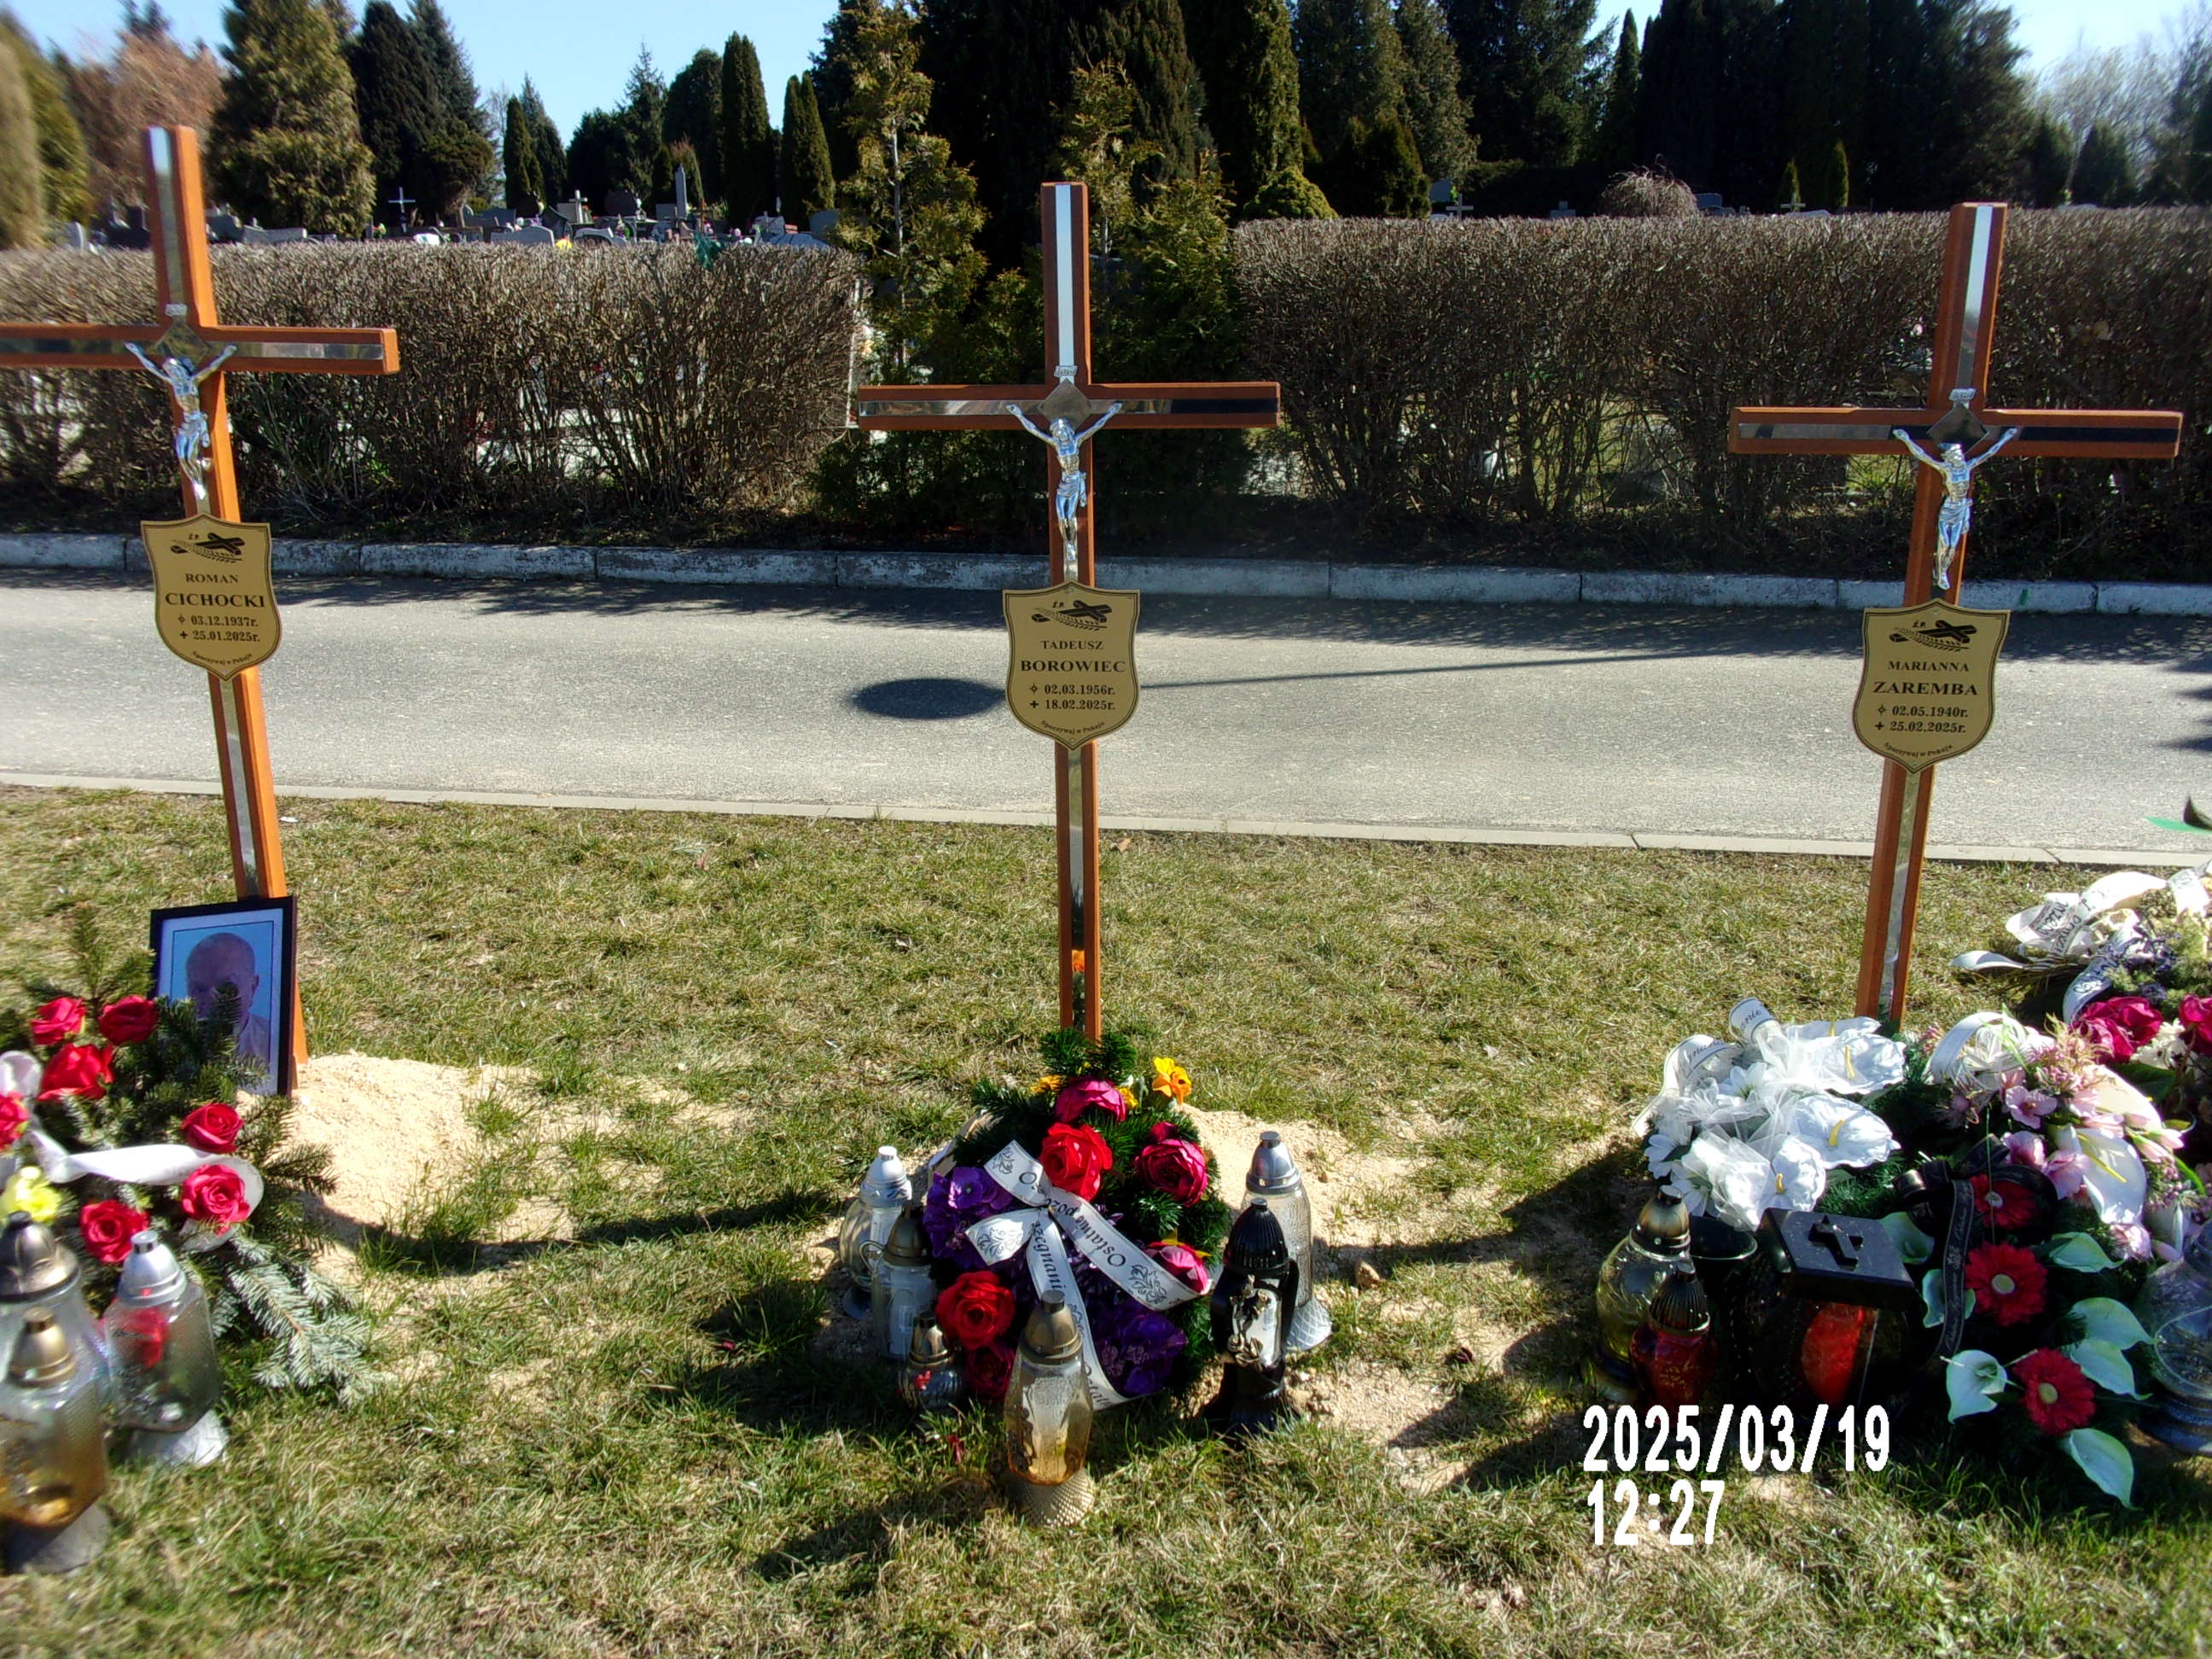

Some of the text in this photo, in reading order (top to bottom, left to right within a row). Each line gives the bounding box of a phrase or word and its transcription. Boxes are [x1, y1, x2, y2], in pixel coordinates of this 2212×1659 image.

[185, 573, 239, 584] ROMAN
[165, 592, 265, 608] CICHOCKI
[190, 615, 259, 627] 03.12.1937r.
[192, 631, 260, 643] 25.01.2025r.
[1041, 640, 1104, 650] TADEUSZ
[1021, 661, 1126, 673] BOROWIEC
[1887, 661, 1970, 672] MARIANNA
[1044, 684, 1115, 696] 02.03.1956r.
[1872, 681, 1978, 696] ZAREMBA
[1045, 699, 1115, 710] 18.02.2025r.
[1891, 706, 1969, 718] 02.05.1940r.
[1889, 721, 1967, 734] 25.02.2025r.
